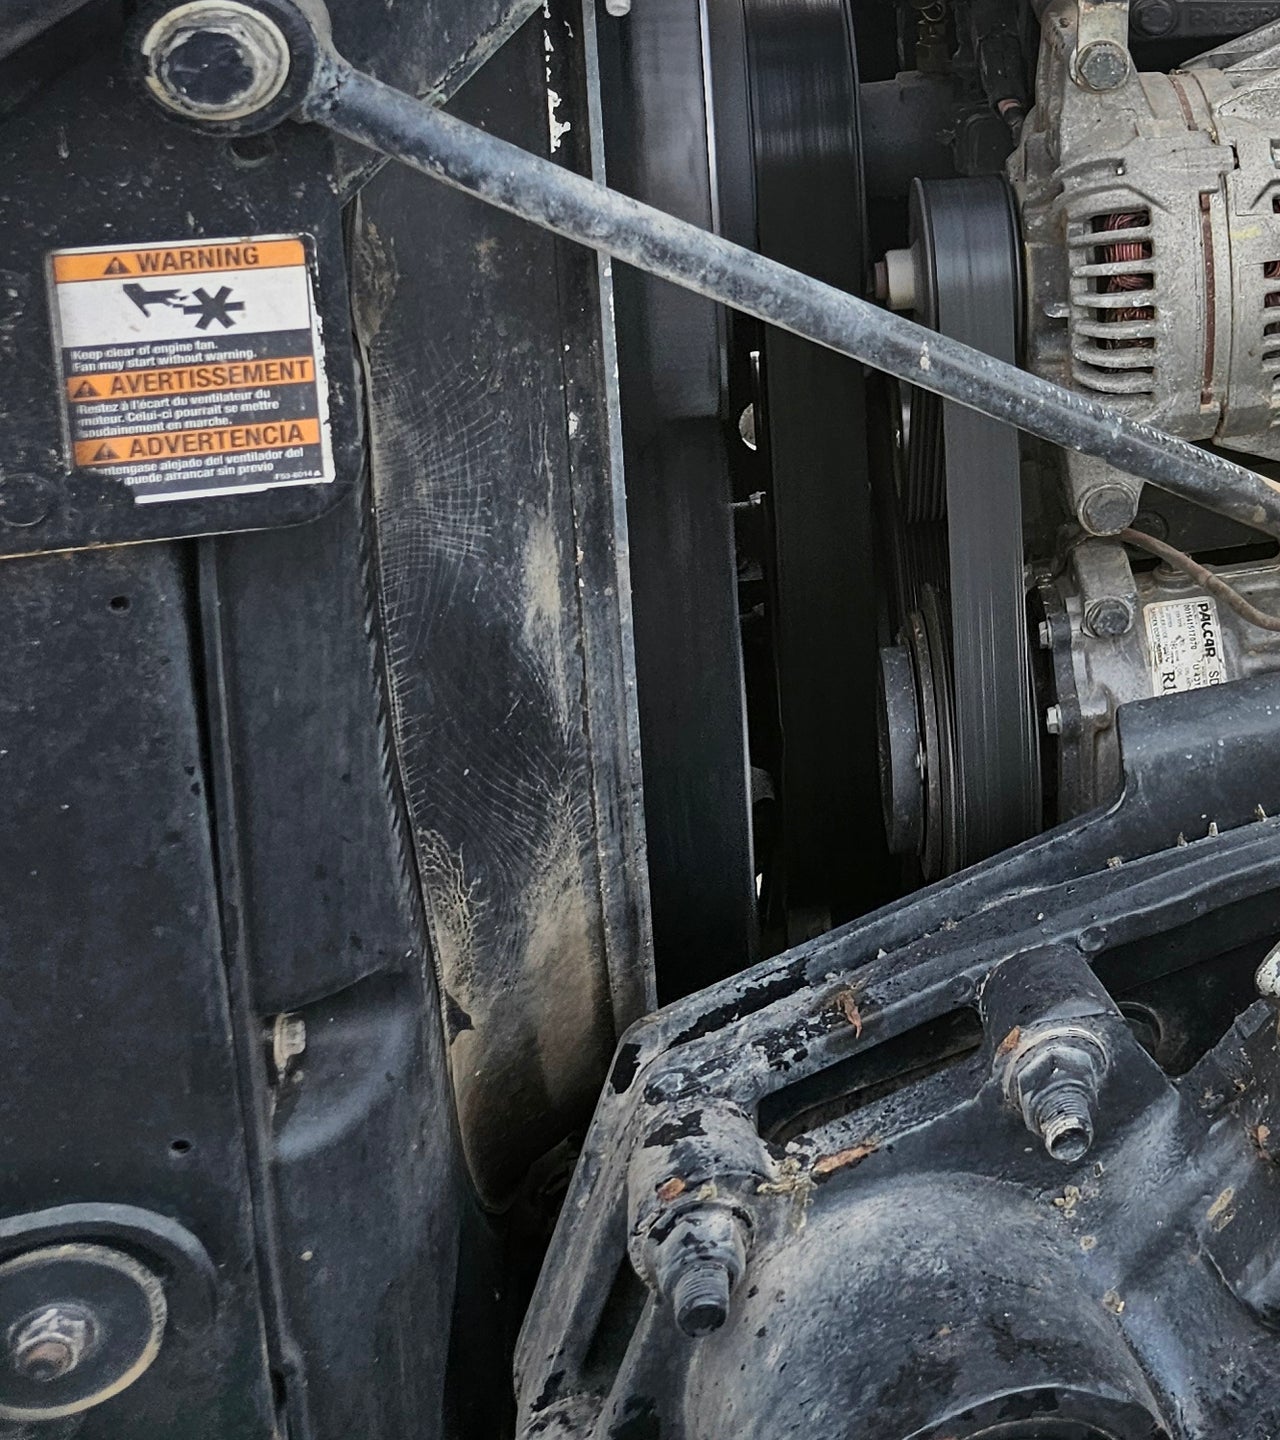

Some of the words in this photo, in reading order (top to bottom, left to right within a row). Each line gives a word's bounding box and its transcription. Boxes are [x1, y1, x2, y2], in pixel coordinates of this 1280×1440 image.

[136, 246, 259, 272] WARNING
[70, 350, 103, 361] Keep
[106, 347, 134, 357] clear
[137, 345, 150, 355] of
[151, 343, 192, 355] engine
[195, 341, 217, 350] fan.
[72, 362, 98, 372] Fan
[98, 361, 124, 371] may
[126, 356, 155, 367] start
[158, 352, 202, 365] without
[204, 350, 256, 361] warning.
[108, 359, 310, 395] AVERTISSEMENT
[76, 403, 118, 414] Restez
[171, 396, 187, 406] du
[190, 392, 251, 404] ventilateur
[255, 389, 270, 399] du
[78, 414, 124, 425] moteur.
[127, 408, 172, 421] Celui-ci
[175, 404, 221, 420] pourrait
[224, 405, 237, 413] se
[240, 400, 279, 412] mettre
[80, 422, 163, 437] soudainement
[166, 422, 181, 430] en
[184, 417, 232, 428] marche.
[127, 423, 304, 457] ADVERTENCIA
[90, 463, 157, 476] ntengase
[160, 458, 202, 471] alejado
[205, 455, 223, 465] del
[226, 451, 282, 463] ventilador
[285, 448, 303, 458] del
[124, 473, 162, 487] puede
[165, 470, 214, 481] arrancar
[217, 466, 234, 476] sin
[237, 463, 273, 476] previo
[1197, 603, 1216, 658] PACCAR
[1162, 671, 1177, 695] R1
